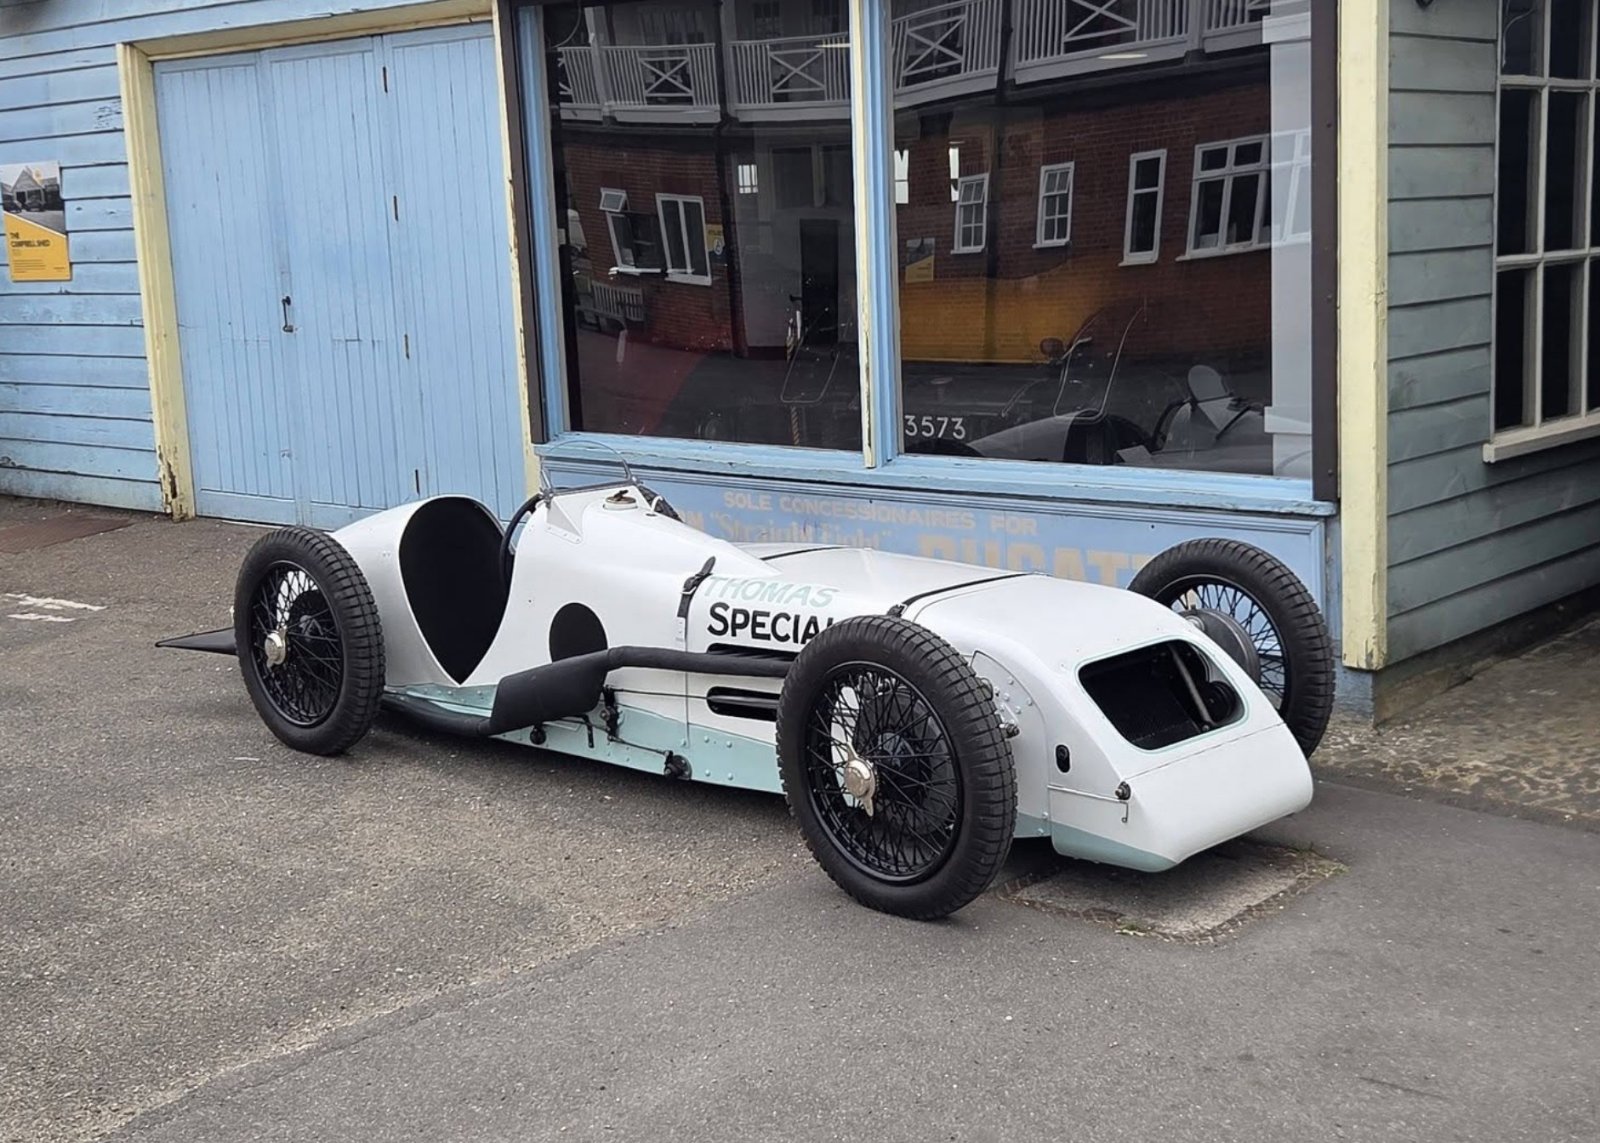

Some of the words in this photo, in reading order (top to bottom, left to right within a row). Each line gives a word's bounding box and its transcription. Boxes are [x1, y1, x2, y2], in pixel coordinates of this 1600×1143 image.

[904, 414, 966, 440] 3573
[723, 490, 773, 511] SOLE
[779, 495, 976, 530] CONCESSIONAIRES
[991, 514, 1038, 536] FOR
[704, 576, 840, 608] THOMAS
[707, 601, 834, 645] SPECIA
